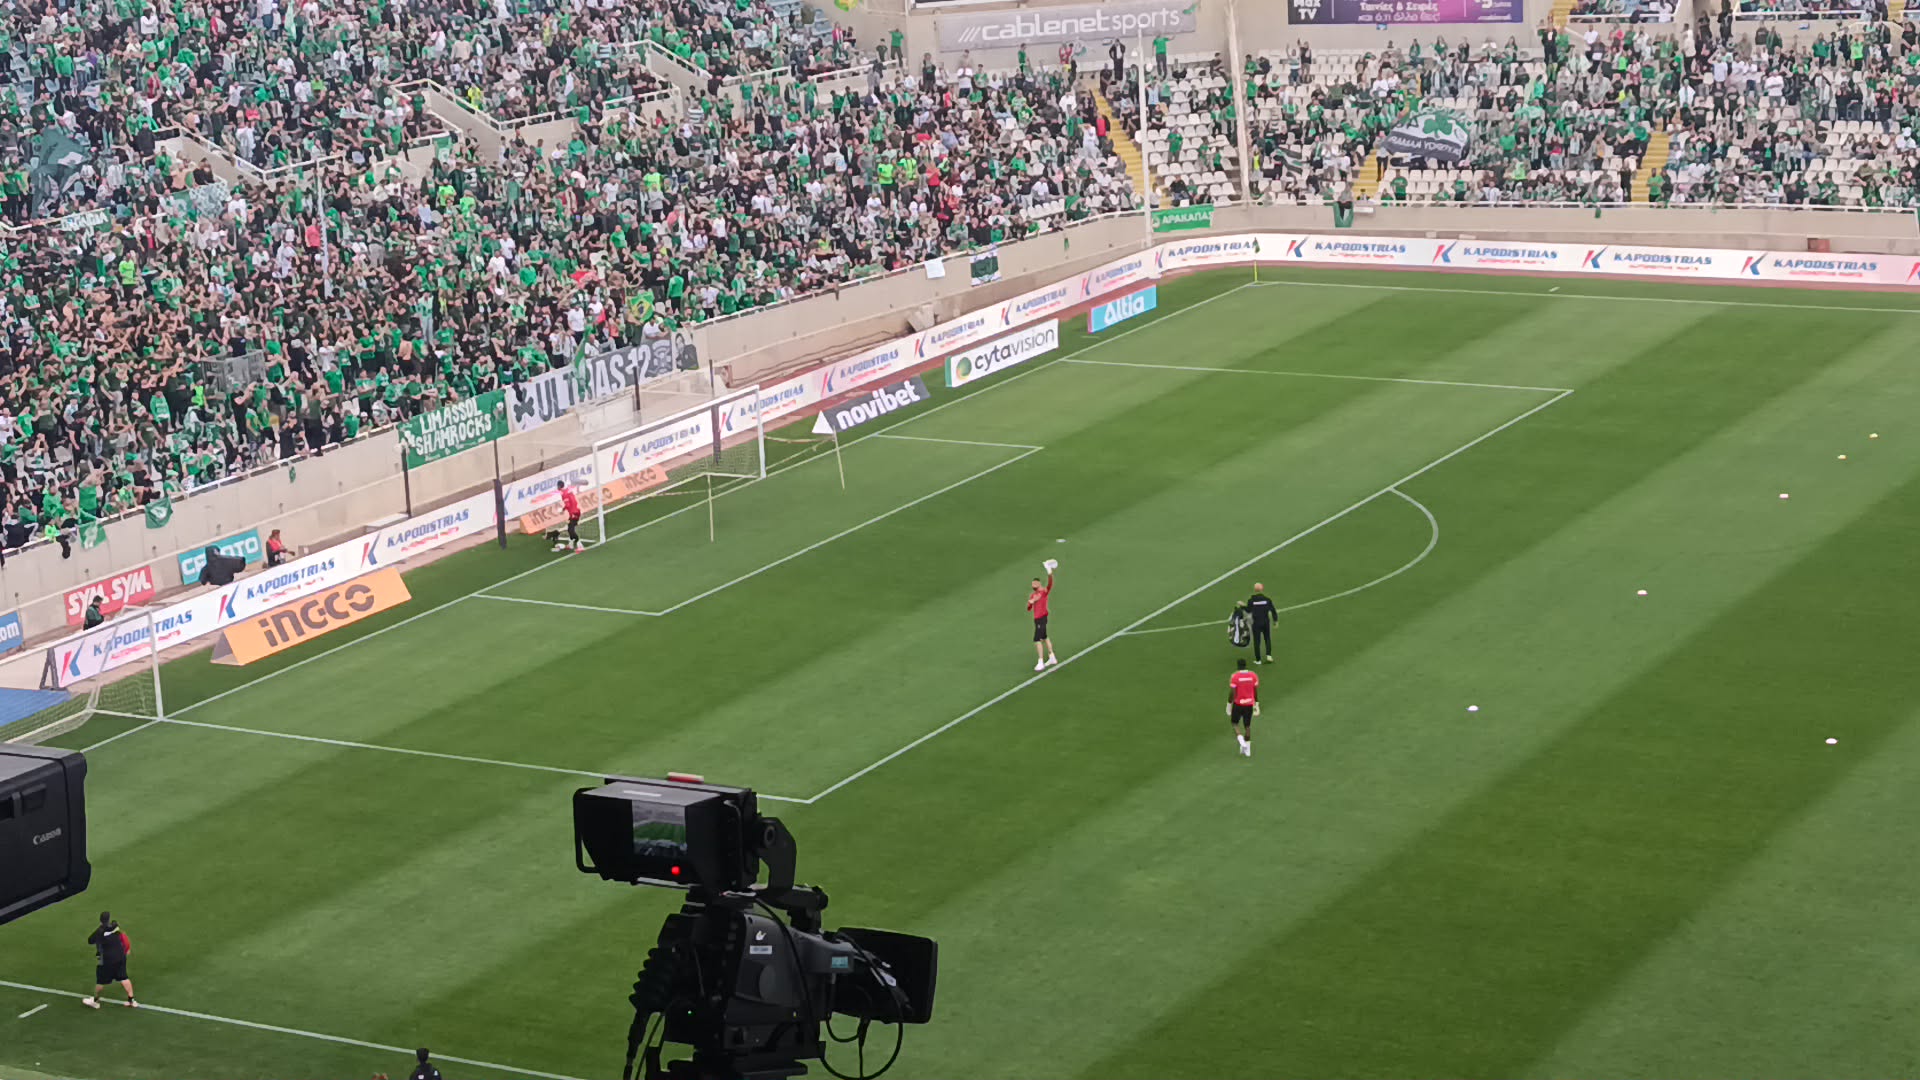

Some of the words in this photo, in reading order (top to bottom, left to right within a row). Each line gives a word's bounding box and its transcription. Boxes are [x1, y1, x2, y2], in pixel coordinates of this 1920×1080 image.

[1298, 8, 1318, 21] TV
[1315, 243, 1406, 255] KAPODISTRIAS
[1464, 247, 1558, 259] KAPODISTRIAS
[1614, 252, 1712, 265] KAPODISTRIAS
[1774, 259, 1878, 271] KAPODISTRIAS
[1104, 294, 1144, 325] Altia
[974, 328, 1055, 371] cytavision
[420, 397, 483, 434] LIMASSOL
[836, 380, 921, 430] novibet
[415, 413, 492, 456] SHAMROCKS
[387, 508, 469, 548] KAPODISTRIAS
[247, 557, 335, 600] KAPODISTRIAS
[93, 609, 192, 657] KAPODISTRIAS
